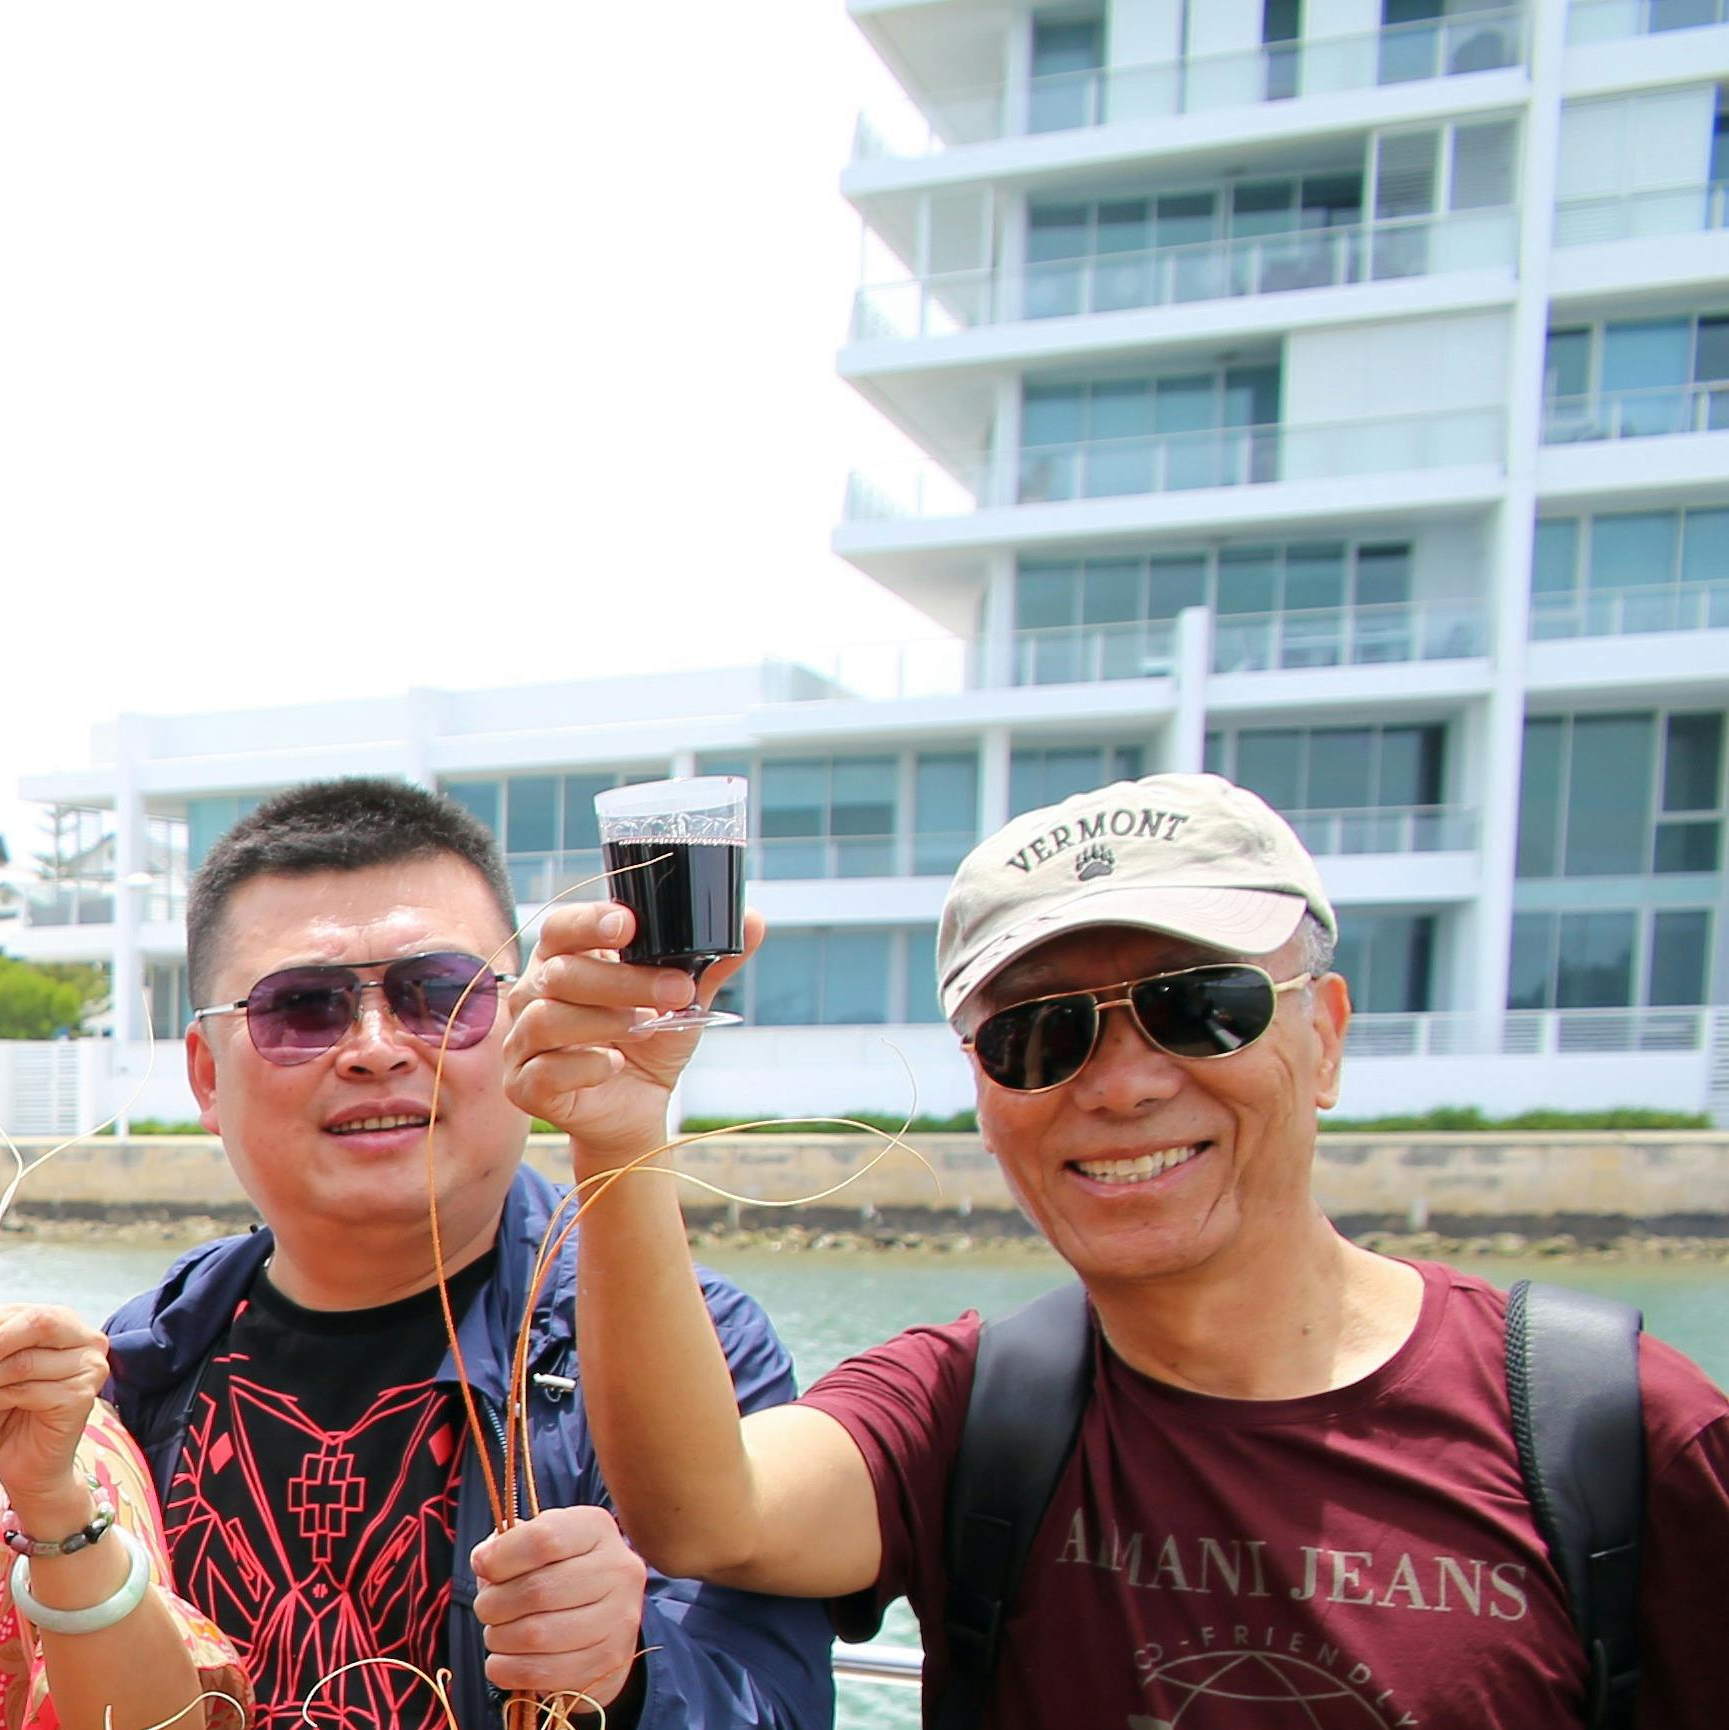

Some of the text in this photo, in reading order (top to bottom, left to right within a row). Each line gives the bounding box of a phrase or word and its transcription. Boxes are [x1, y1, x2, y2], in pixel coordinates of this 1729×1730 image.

[1006, 808, 1189, 873] VERMONT
[1055, 1506, 1529, 1621] AMANI JEANS
